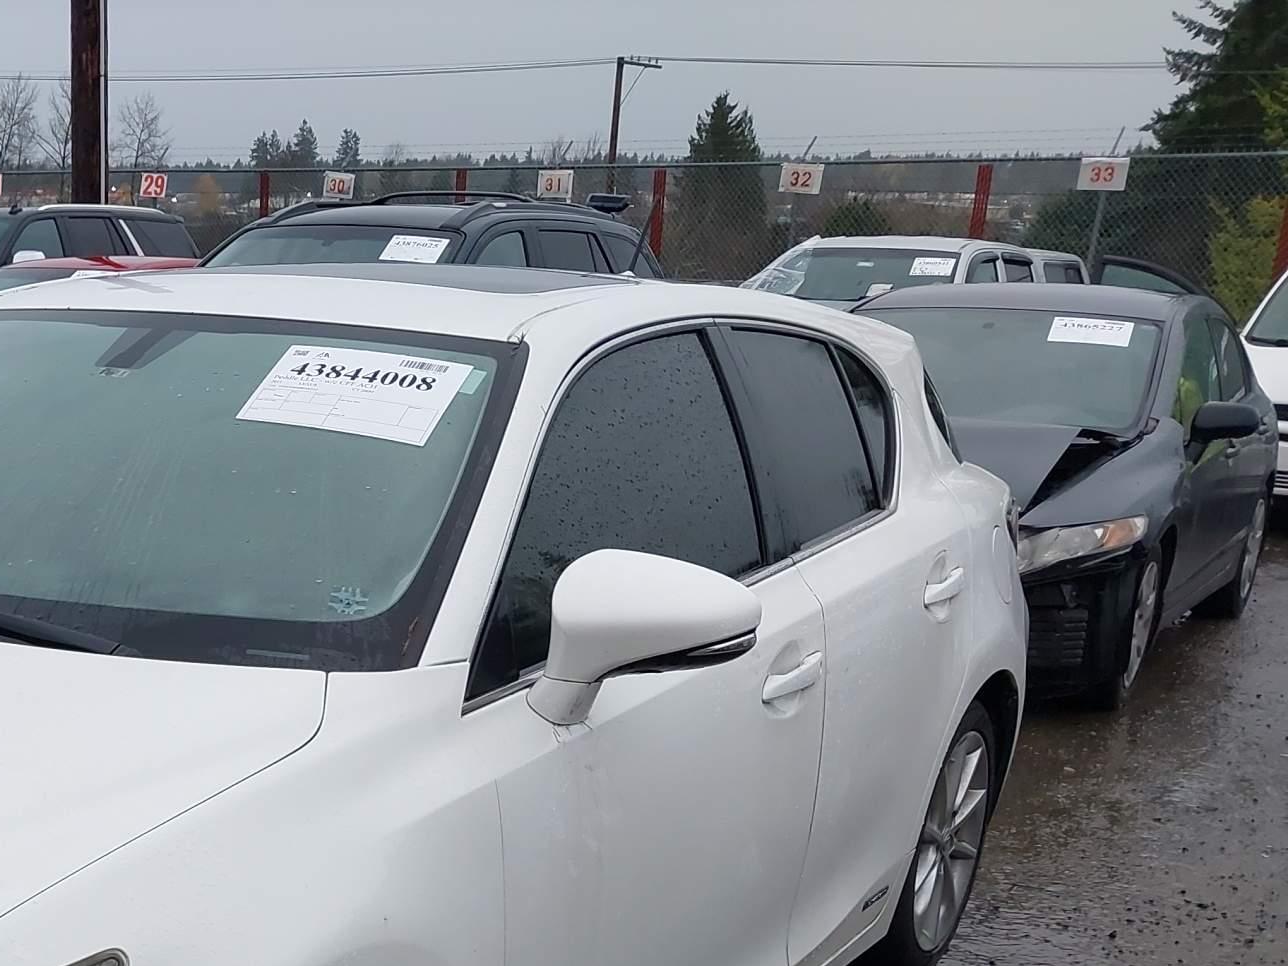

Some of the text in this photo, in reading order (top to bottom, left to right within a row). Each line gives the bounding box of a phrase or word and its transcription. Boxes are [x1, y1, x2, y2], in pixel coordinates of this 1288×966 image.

[789, 171, 812, 188] 32
[1089, 166, 1115, 183] 33
[142, 174, 165, 196] 29
[329, 178, 345, 194] 30
[544, 177, 562, 193] 31
[289, 361, 437, 392] 43844008
